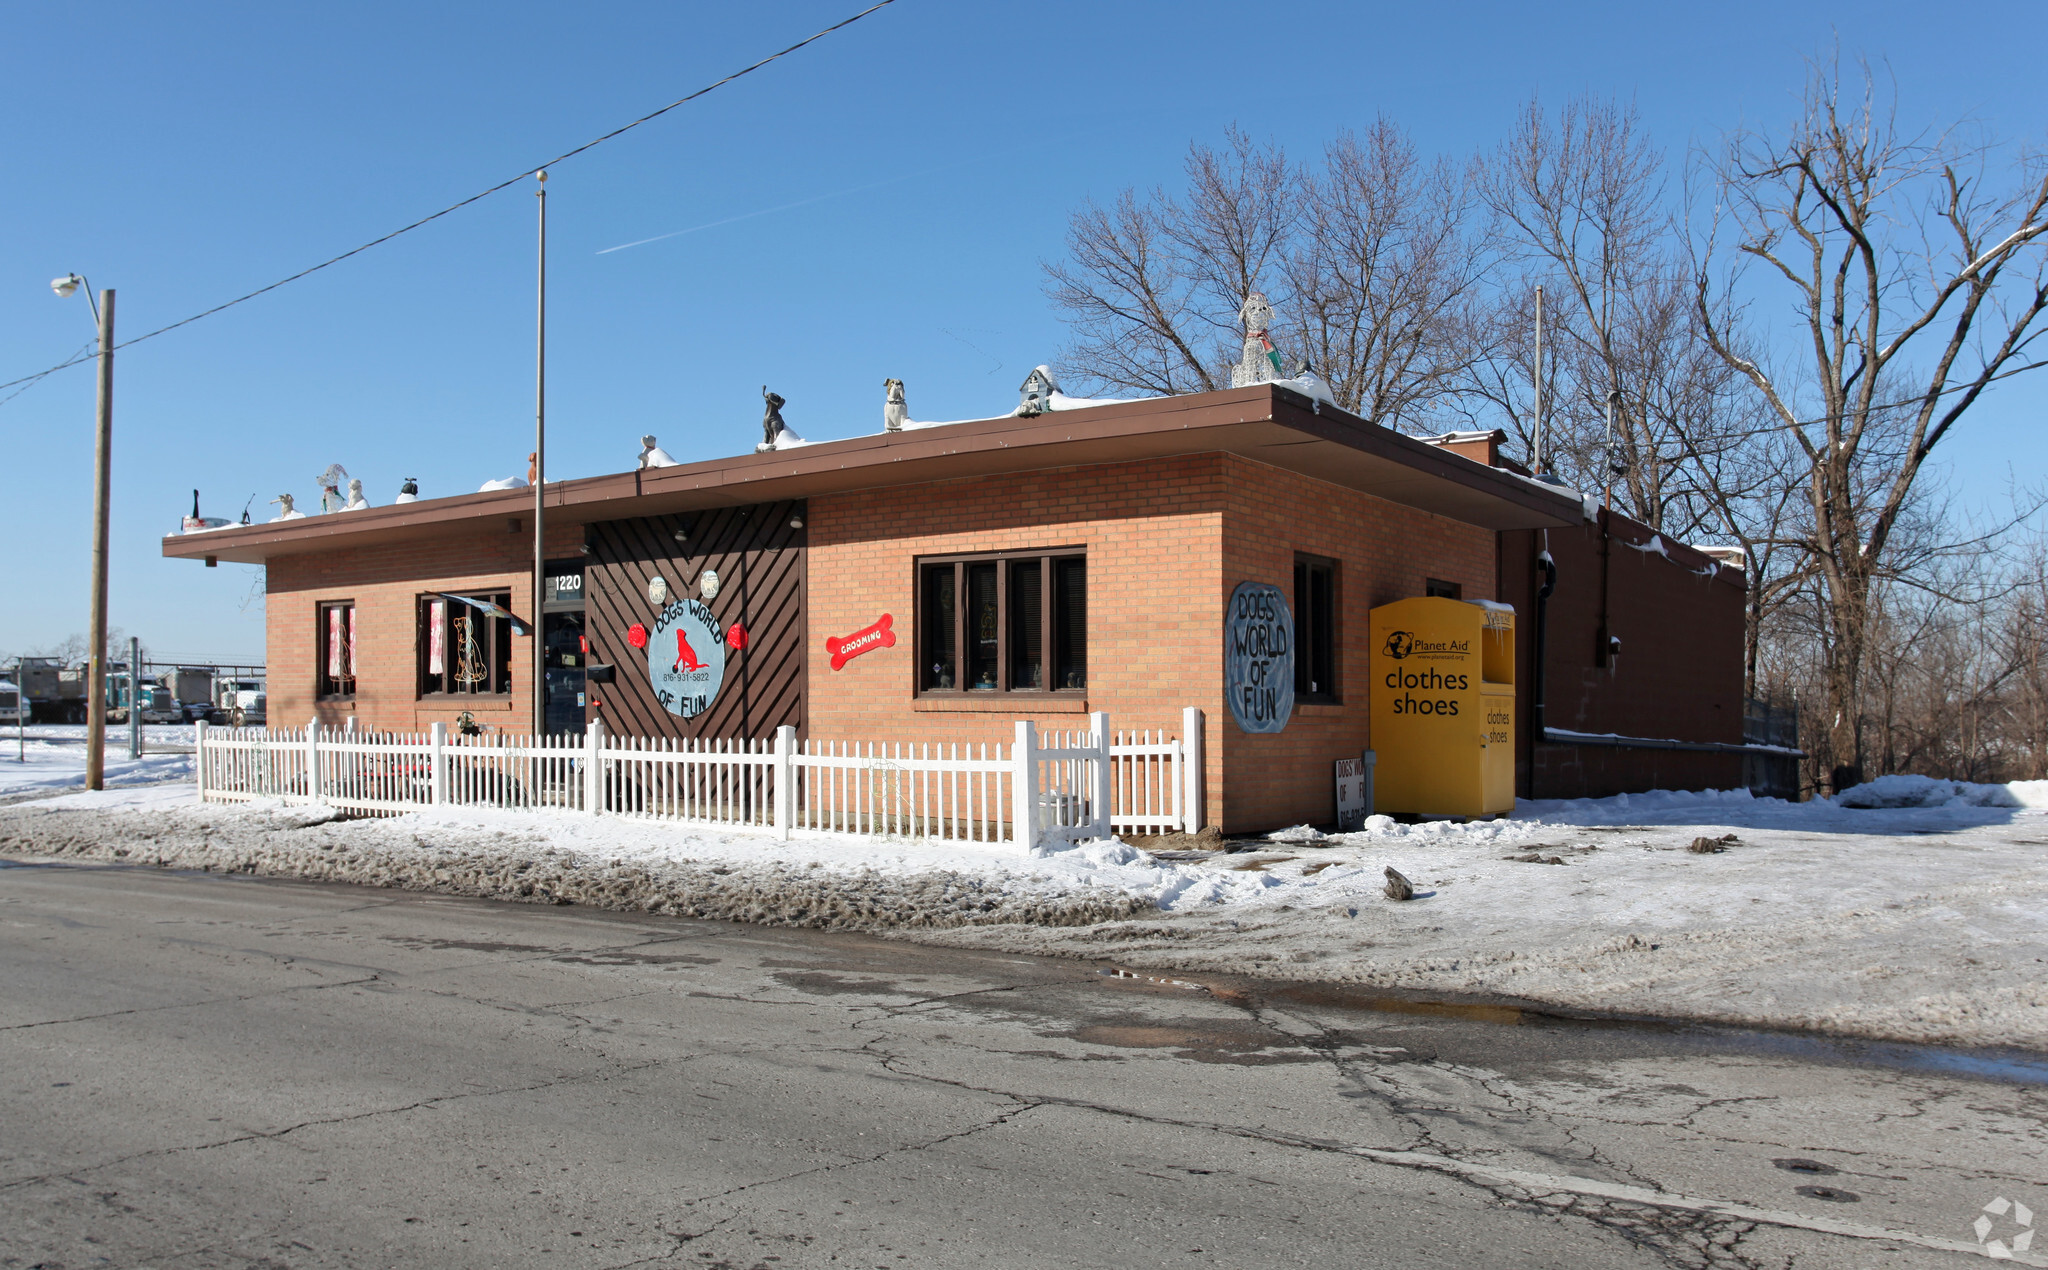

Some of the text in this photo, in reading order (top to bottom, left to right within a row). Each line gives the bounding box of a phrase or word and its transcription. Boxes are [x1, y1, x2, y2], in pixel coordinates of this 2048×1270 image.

[556, 574, 581, 591] 1220
[1238, 591, 1278, 622] DOGS'
[689, 598, 723, 645] WORLD
[841, 630, 881, 654] GROOMING
[1234, 623, 1287, 658] WORLD
[1414, 639, 1469, 651] Planet Aid
[663, 673, 710, 682] 816-931-5822
[1250, 660, 1270, 688] OF
[1385, 666, 1468, 690] clothes
[658, 689, 707, 717] OF FUN
[1243, 686, 1276, 721] FUN
[1393, 692, 1459, 716] shoes
[1487, 708, 1510, 725] clothes
[1489, 727, 1508, 743] shoes
[1340, 785, 1346, 802] OF
